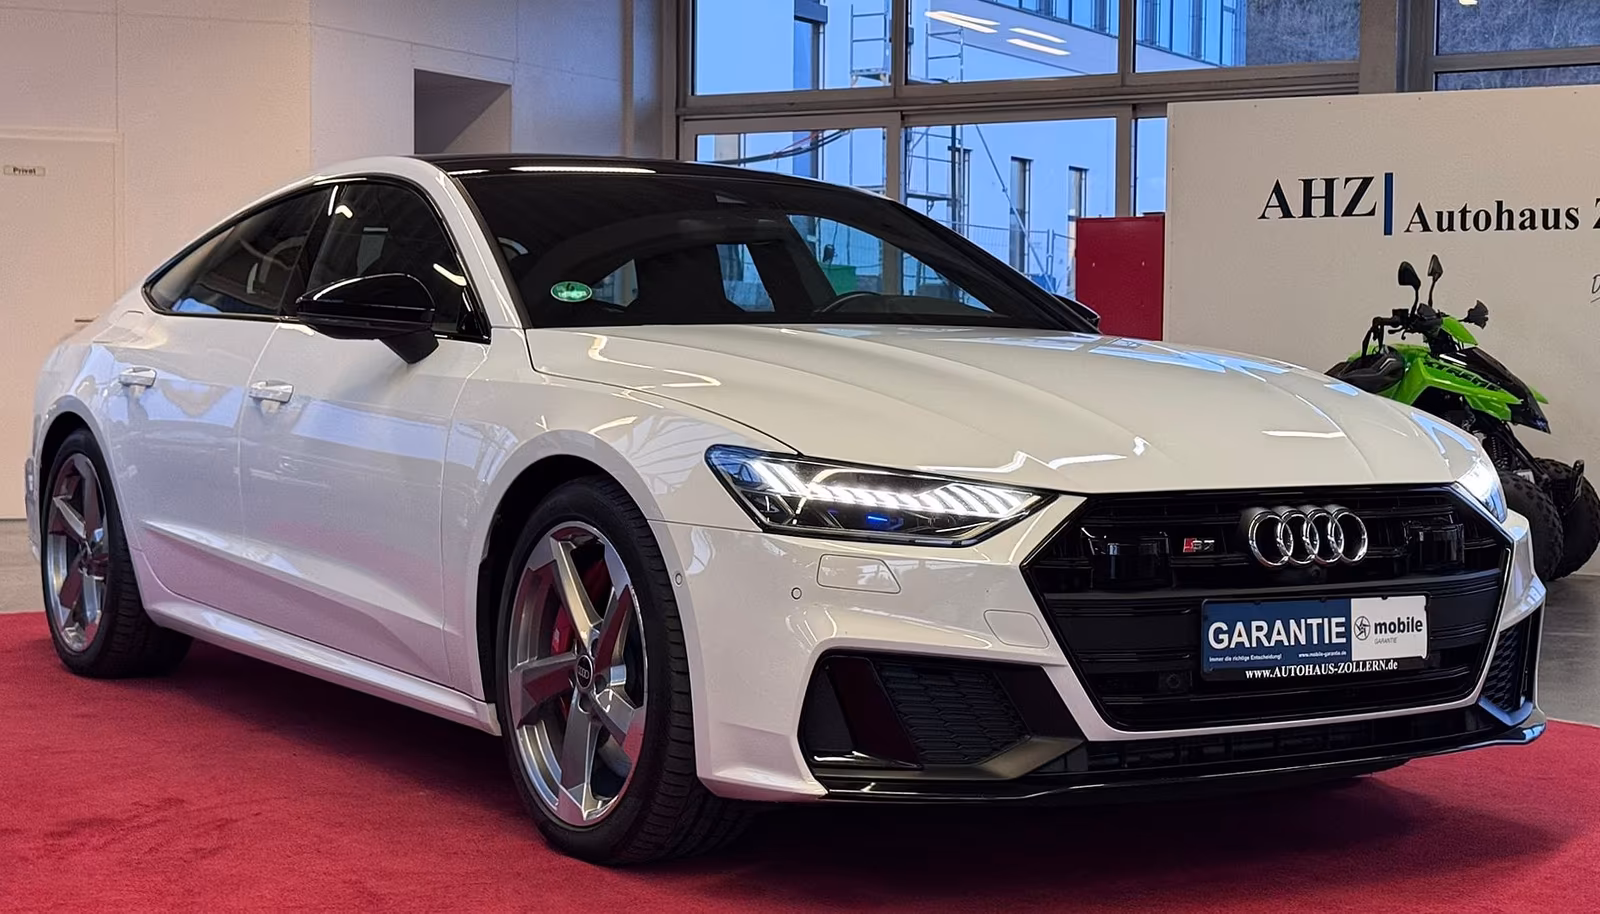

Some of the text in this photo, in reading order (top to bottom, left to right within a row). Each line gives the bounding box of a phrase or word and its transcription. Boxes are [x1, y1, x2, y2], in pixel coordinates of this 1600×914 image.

[1257, 176, 1377, 219] AHZ
[1404, 200, 1580, 233] Autohaus
[1208, 616, 1347, 650] GARANTIE
[1374, 616, 1424, 635] mobile
[1374, 637, 1398, 645] GARANTIE
[1232, 654, 1250, 662] richtige
[1250, 653, 1282, 661] Entscheidung!
[1245, 659, 1399, 679] www.AUTOHAUS-ZOLLERN.de
